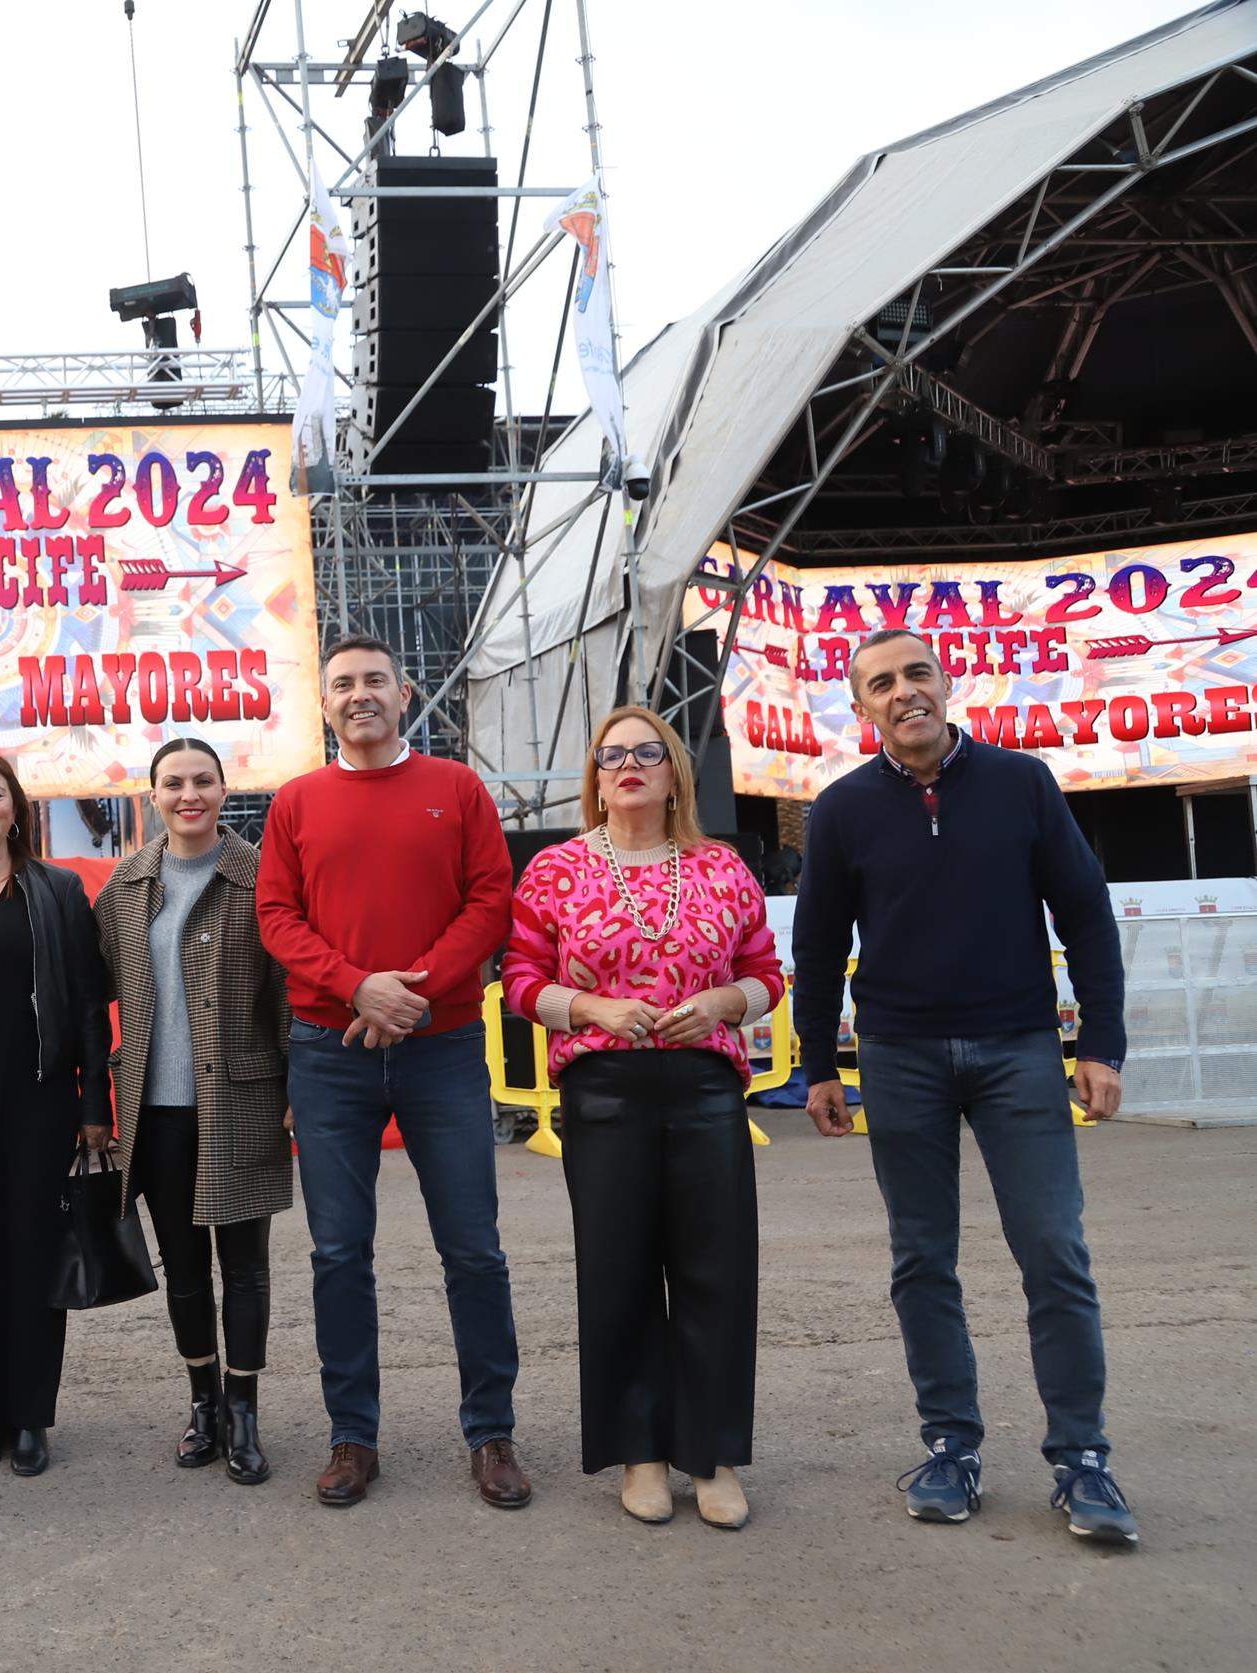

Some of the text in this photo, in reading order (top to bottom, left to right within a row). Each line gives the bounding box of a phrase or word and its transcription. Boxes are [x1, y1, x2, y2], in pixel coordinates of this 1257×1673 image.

[87, 448, 277, 529] 2024
[1044, 555, 1257, 624] 202
[19, 648, 272, 729] MAYORES
[795, 626, 1069, 681] ARCIFE
[746, 700, 822, 757] GALA
[966, 685, 1257, 749] MAYORE
